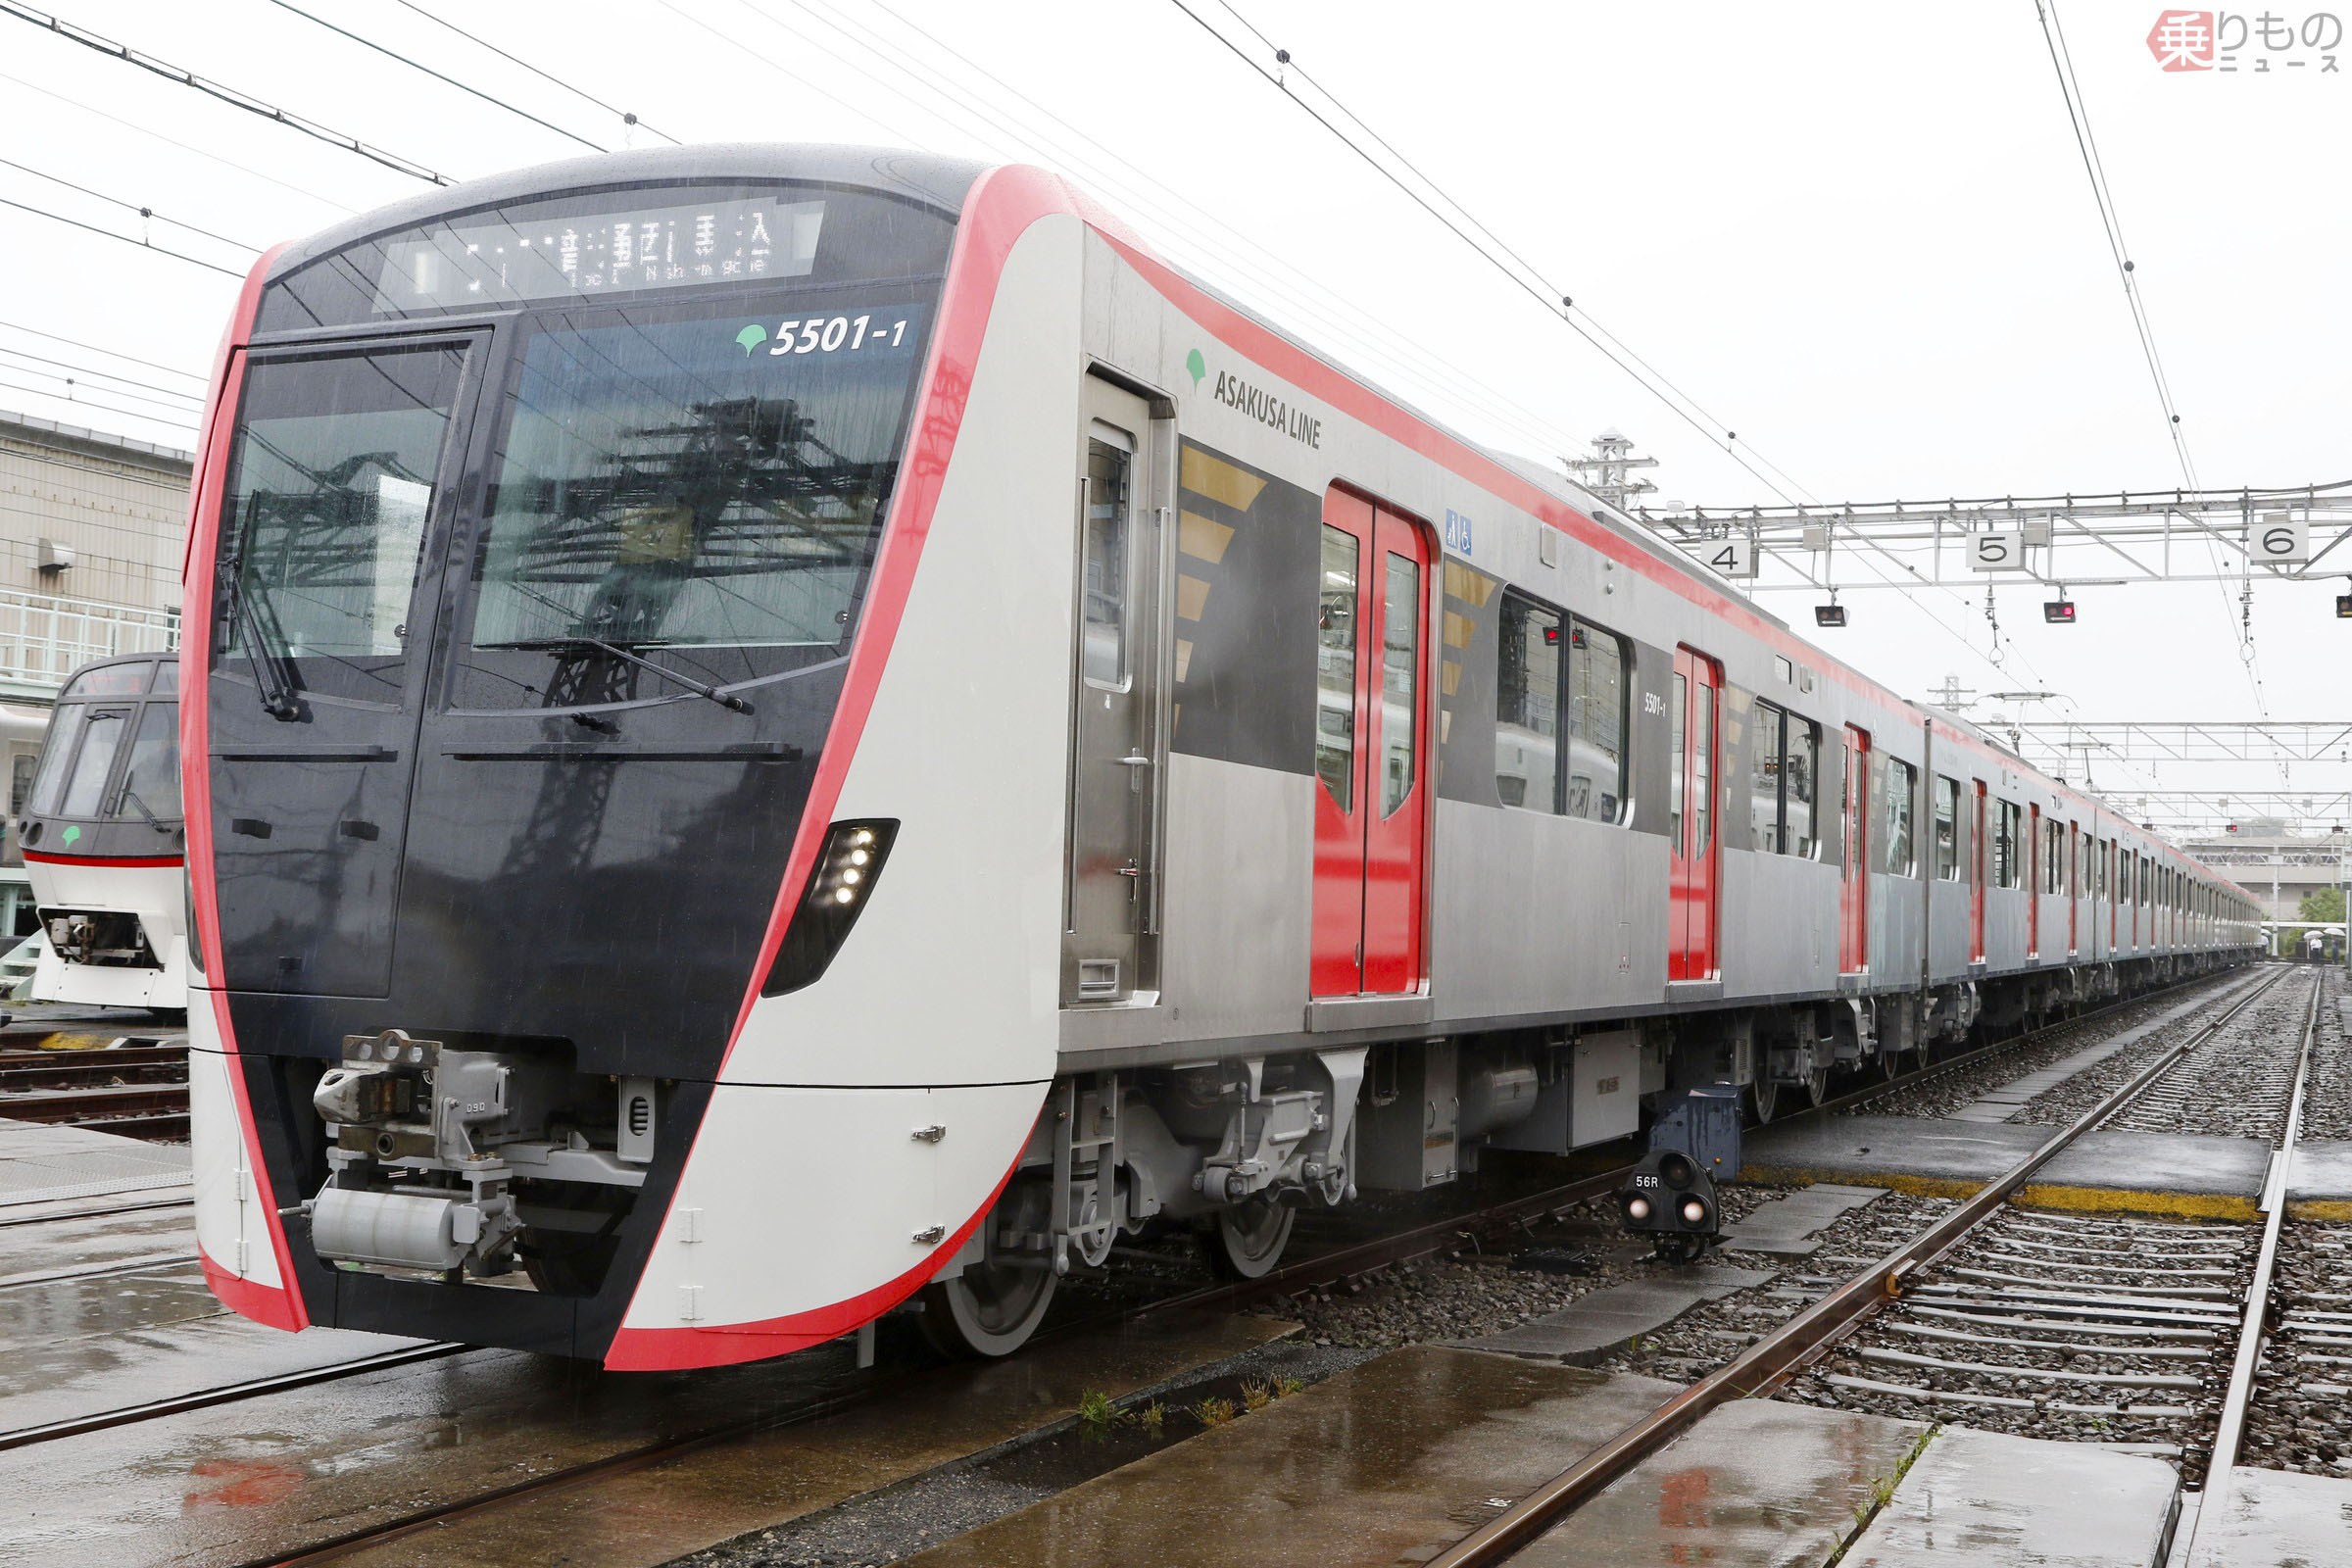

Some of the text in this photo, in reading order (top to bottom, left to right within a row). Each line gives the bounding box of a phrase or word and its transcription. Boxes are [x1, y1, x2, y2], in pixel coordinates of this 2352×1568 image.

[769, 315, 907, 356] 5501-1
[1214, 370, 1321, 450] ASAKUSA LINE
[1979, 536, 2008, 563] 5
[2262, 527, 2295, 555] 6
[1711, 545, 1739, 571] 4
[1644, 691, 1666, 717] 5501-1
[1636, 1176, 1658, 1188] 56R
